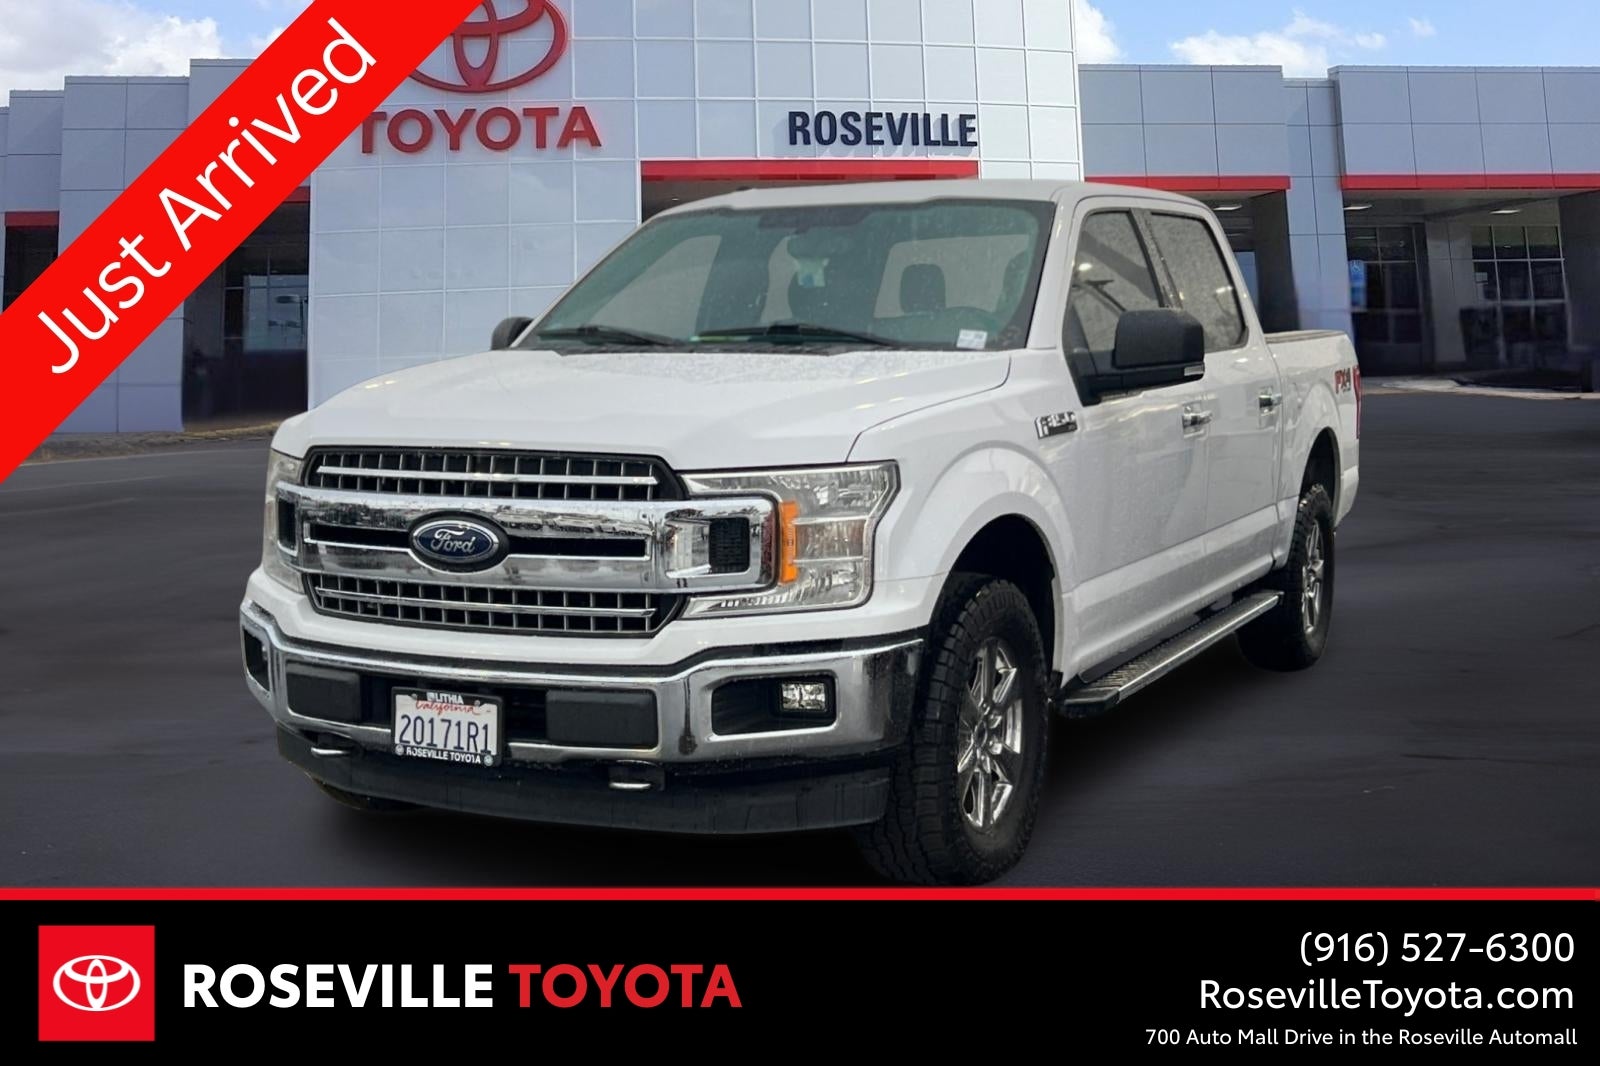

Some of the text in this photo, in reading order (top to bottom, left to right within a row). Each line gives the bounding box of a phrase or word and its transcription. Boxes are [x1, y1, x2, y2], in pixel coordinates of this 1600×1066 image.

[362, 106, 602, 153] TOYOTA
[788, 111, 977, 147] ROSEVILLE
[430, 528, 476, 553] Ford
[416, 700, 480, 715] California
[435, 692, 464, 704] LITHIA
[399, 714, 491, 755] 20171R1
[406, 747, 481, 764] ROSEVILLE TOYOTA
